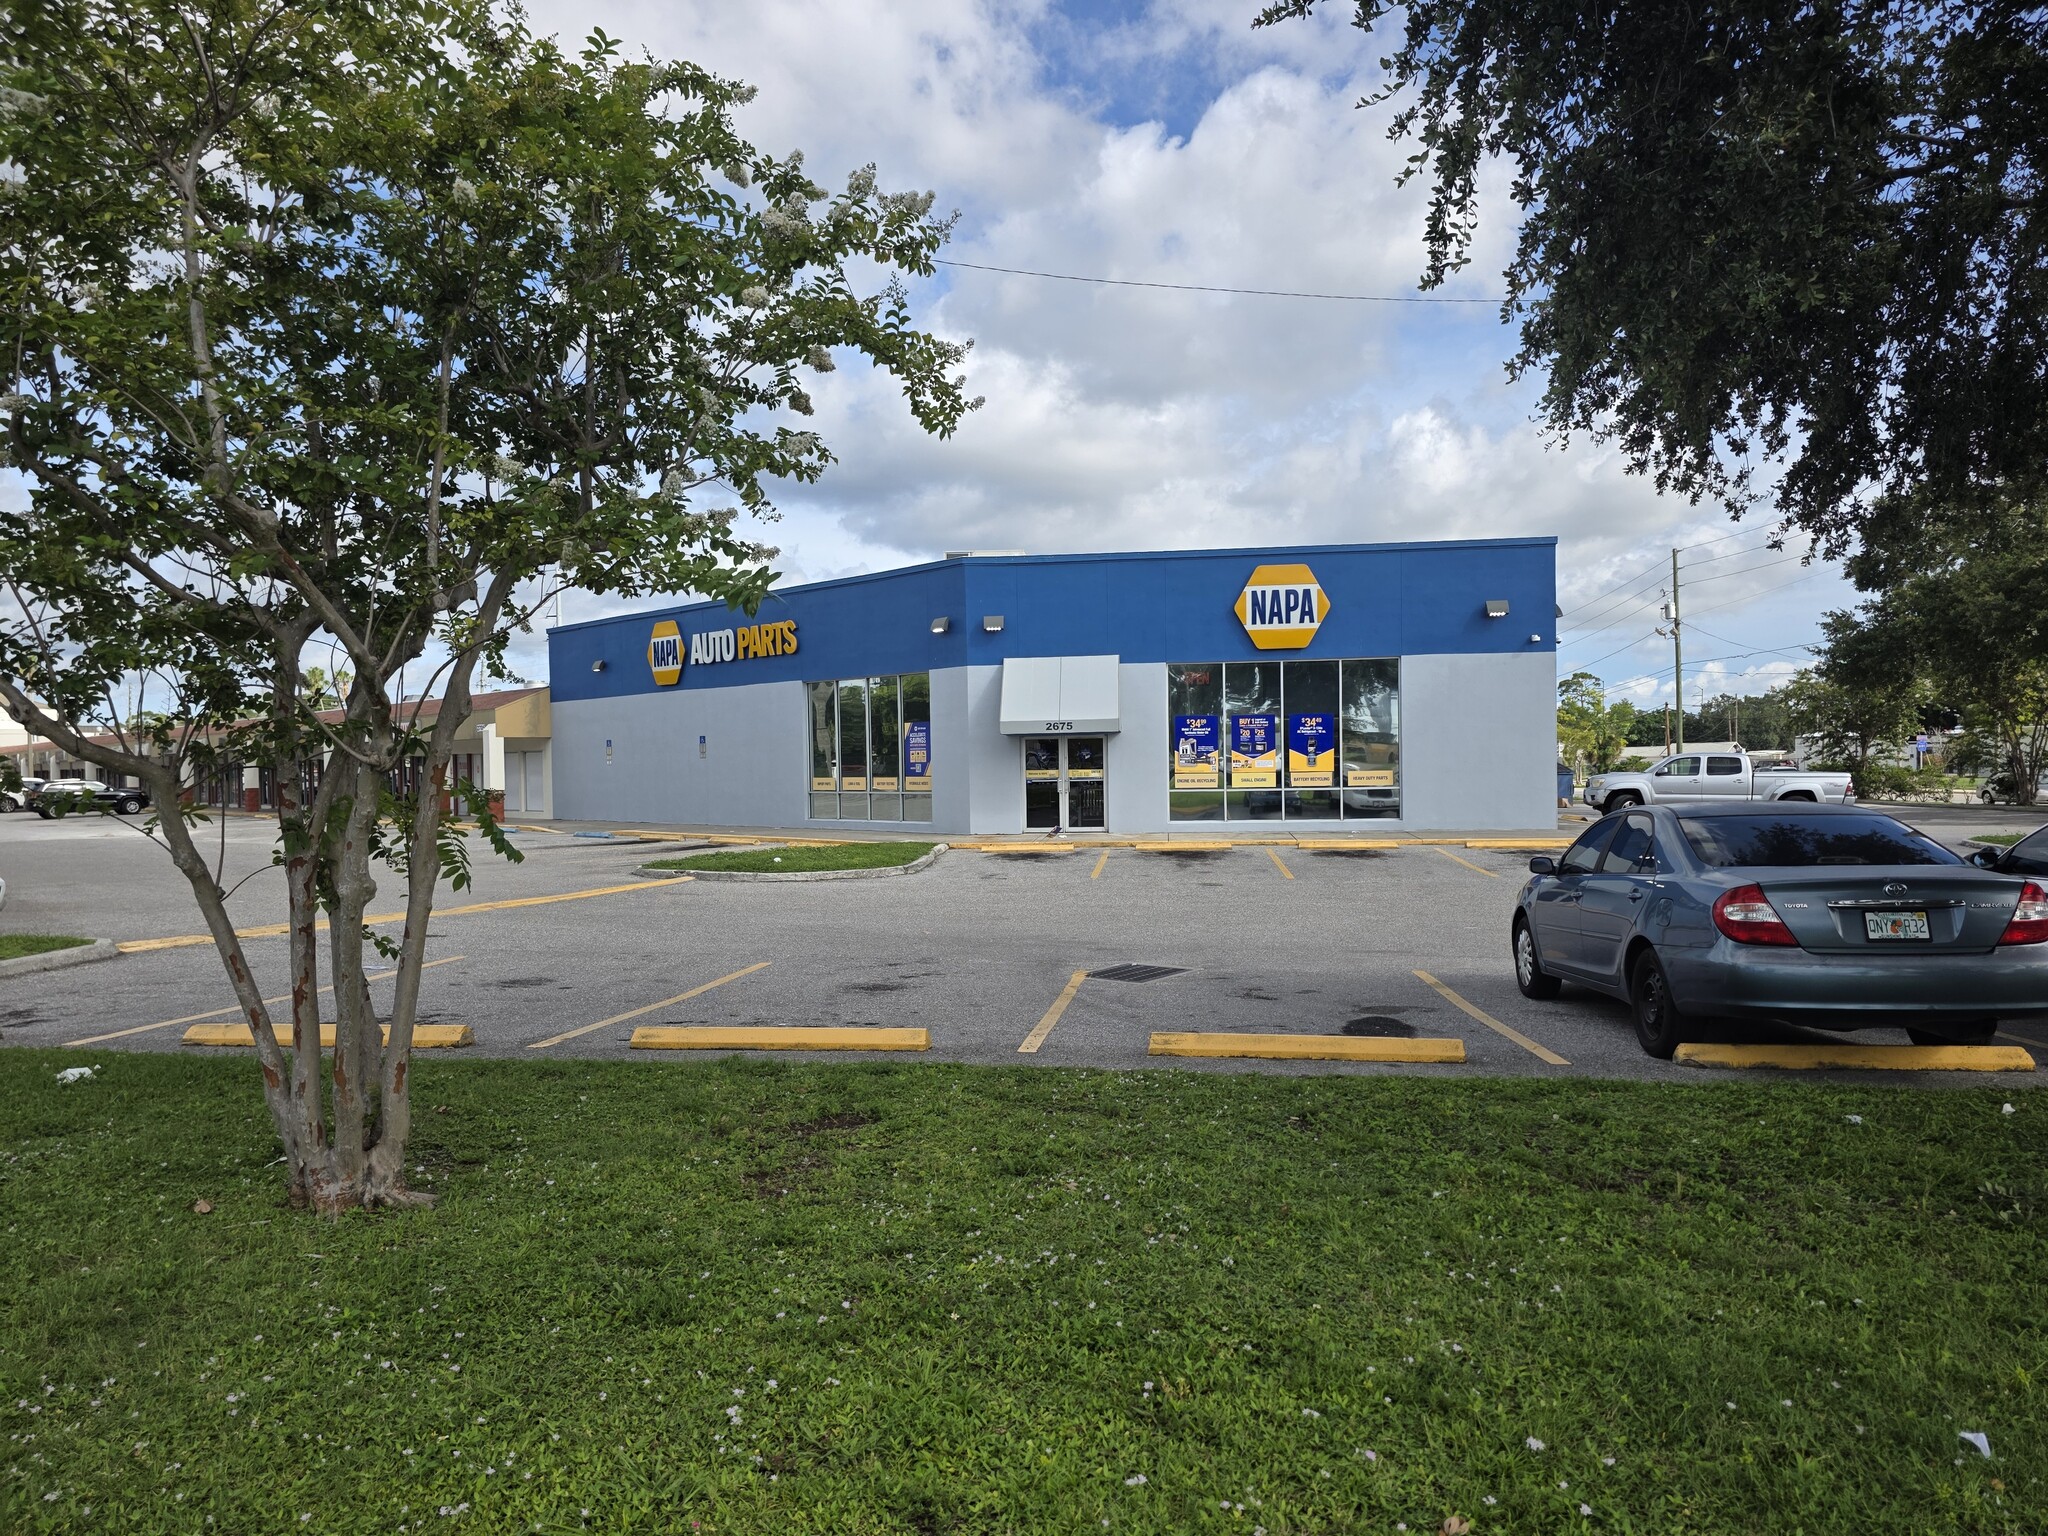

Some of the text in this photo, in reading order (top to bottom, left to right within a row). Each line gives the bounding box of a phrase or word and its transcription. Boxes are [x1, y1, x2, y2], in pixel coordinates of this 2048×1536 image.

[1251, 588, 1315, 625] NAPA
[653, 620, 798, 668] NAPA AUTO PARTS
[1045, 722, 1073, 731] 2675
[1869, 919, 1926, 933] QNY R32
